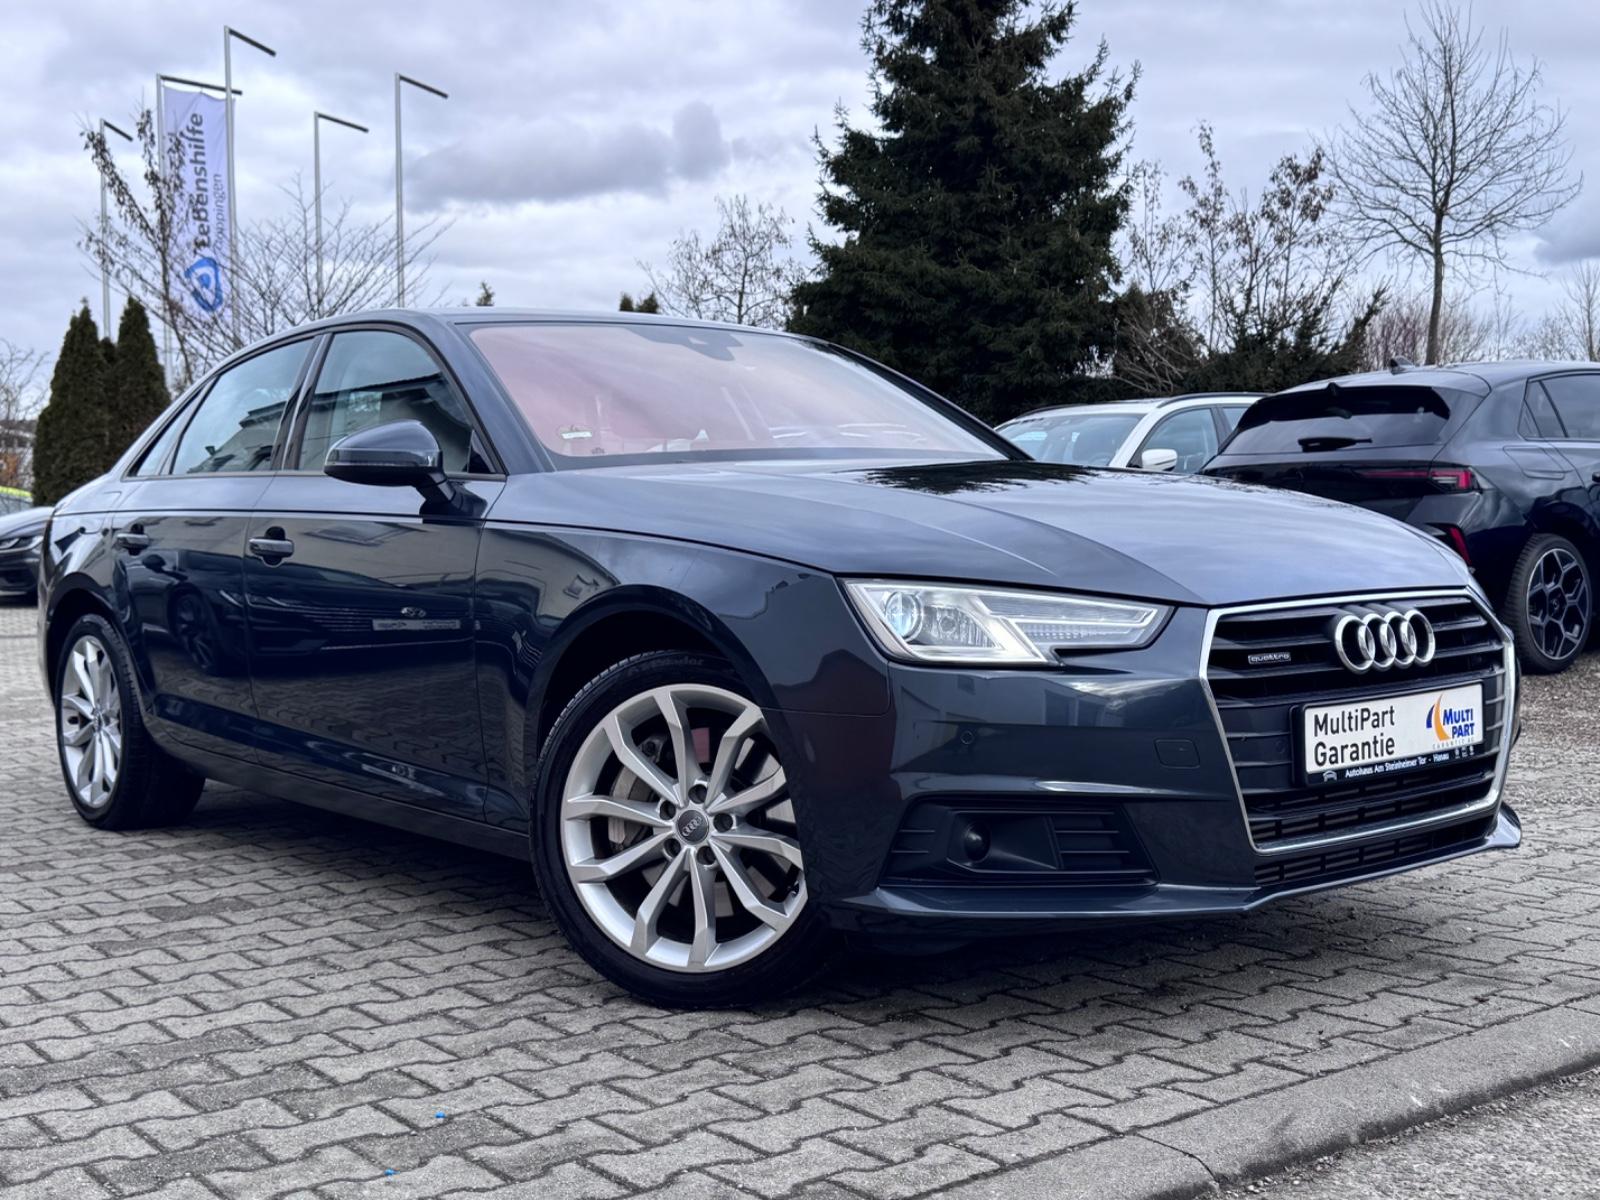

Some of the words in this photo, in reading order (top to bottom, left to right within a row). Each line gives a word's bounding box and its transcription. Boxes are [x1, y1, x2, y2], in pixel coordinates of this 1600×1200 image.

[187, 113, 211, 249] Lebenshilfe
[1250, 653, 1290, 663] quattro
[1314, 705, 1395, 737] MultiPart
[1443, 708, 1474, 725] MULTI
[1451, 723, 1475, 739] PART
[1314, 732, 1395, 767] Garantie
[1345, 766, 1373, 778] Autohaus
[1374, 764, 1384, 773] Am
[1385, 759, 1417, 771] Steinheimer
[1418, 756, 1427, 765] Tor
[1433, 753, 1449, 763] Hanau
